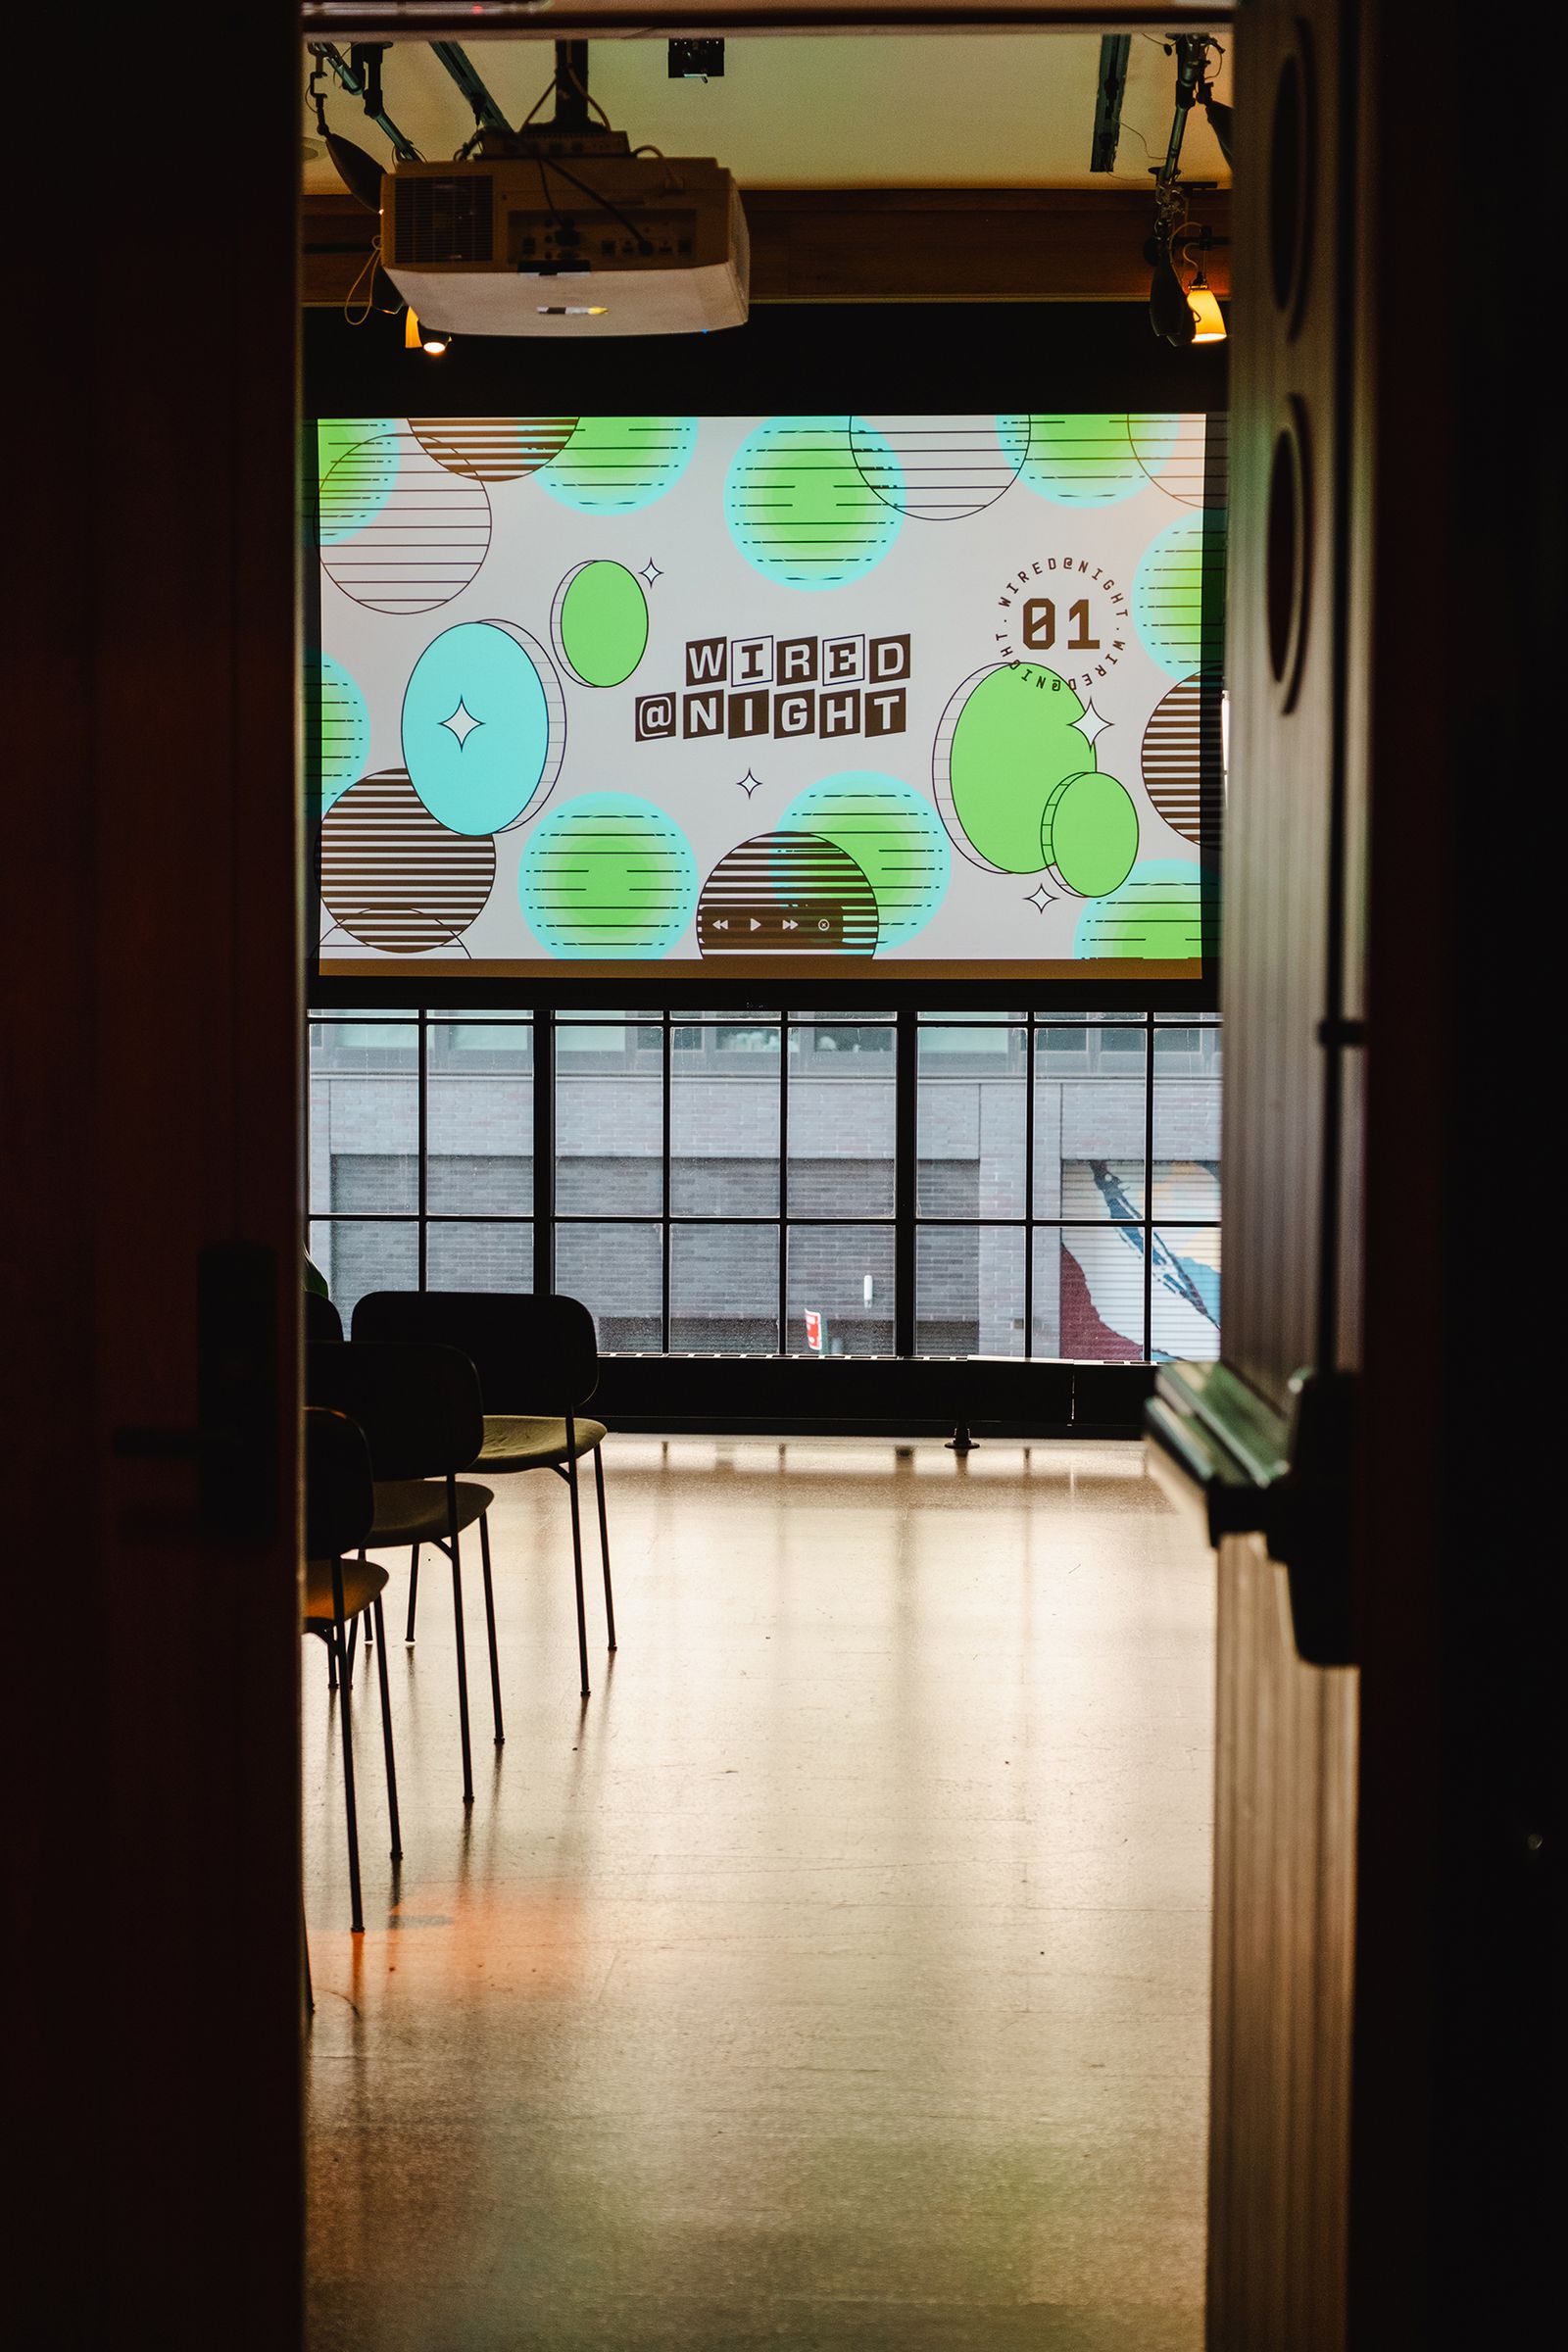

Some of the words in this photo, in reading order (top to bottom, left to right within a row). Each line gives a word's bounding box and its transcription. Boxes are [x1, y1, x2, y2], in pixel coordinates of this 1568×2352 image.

[1022, 598, 1101, 650] 01
[688, 639, 906, 680] WIRED
[638, 694, 901, 738] @NIGHT
